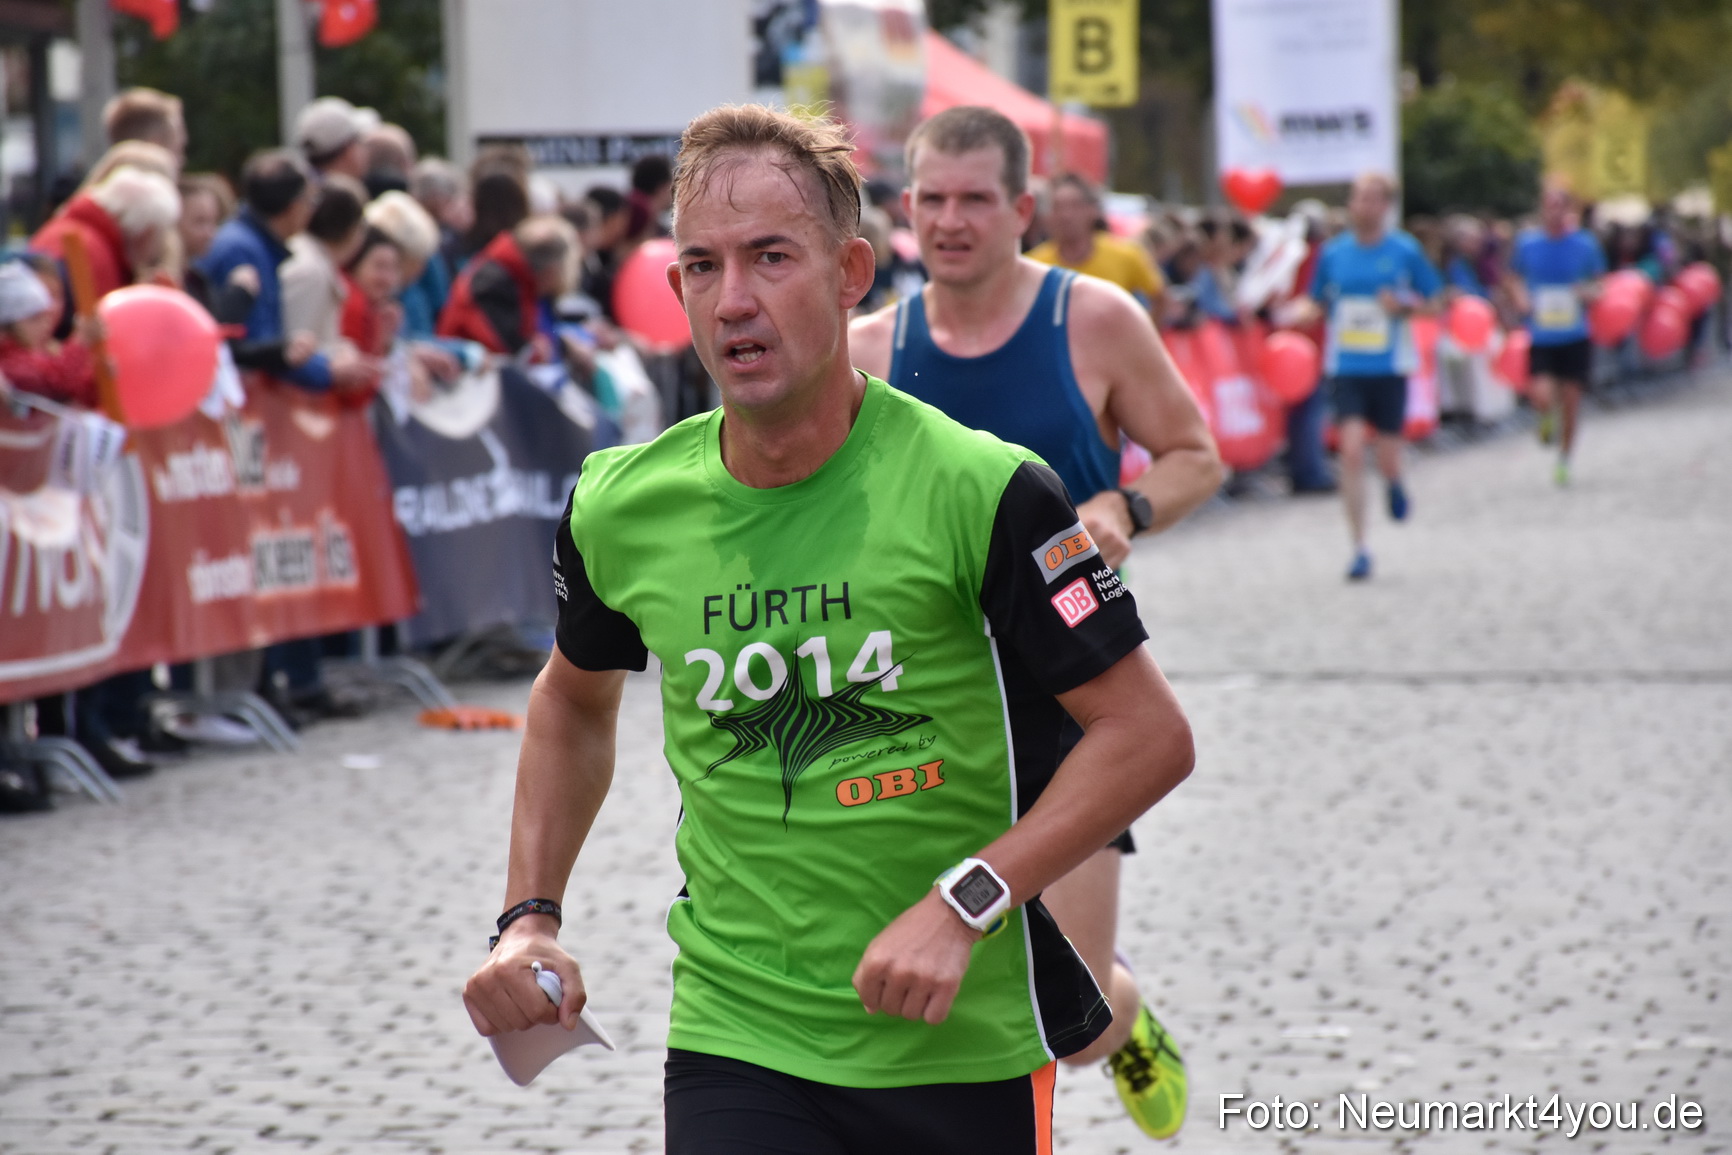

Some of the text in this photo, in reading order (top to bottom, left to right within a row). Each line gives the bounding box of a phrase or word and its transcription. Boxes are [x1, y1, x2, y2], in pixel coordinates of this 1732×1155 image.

[1073, 16, 1114, 76] B
[703, 581, 852, 635] FÜRTH
[1056, 584, 1095, 622] DB
[684, 630, 903, 711] 2014
[828, 734, 937, 770] powered by
[835, 759, 945, 807] OBI
